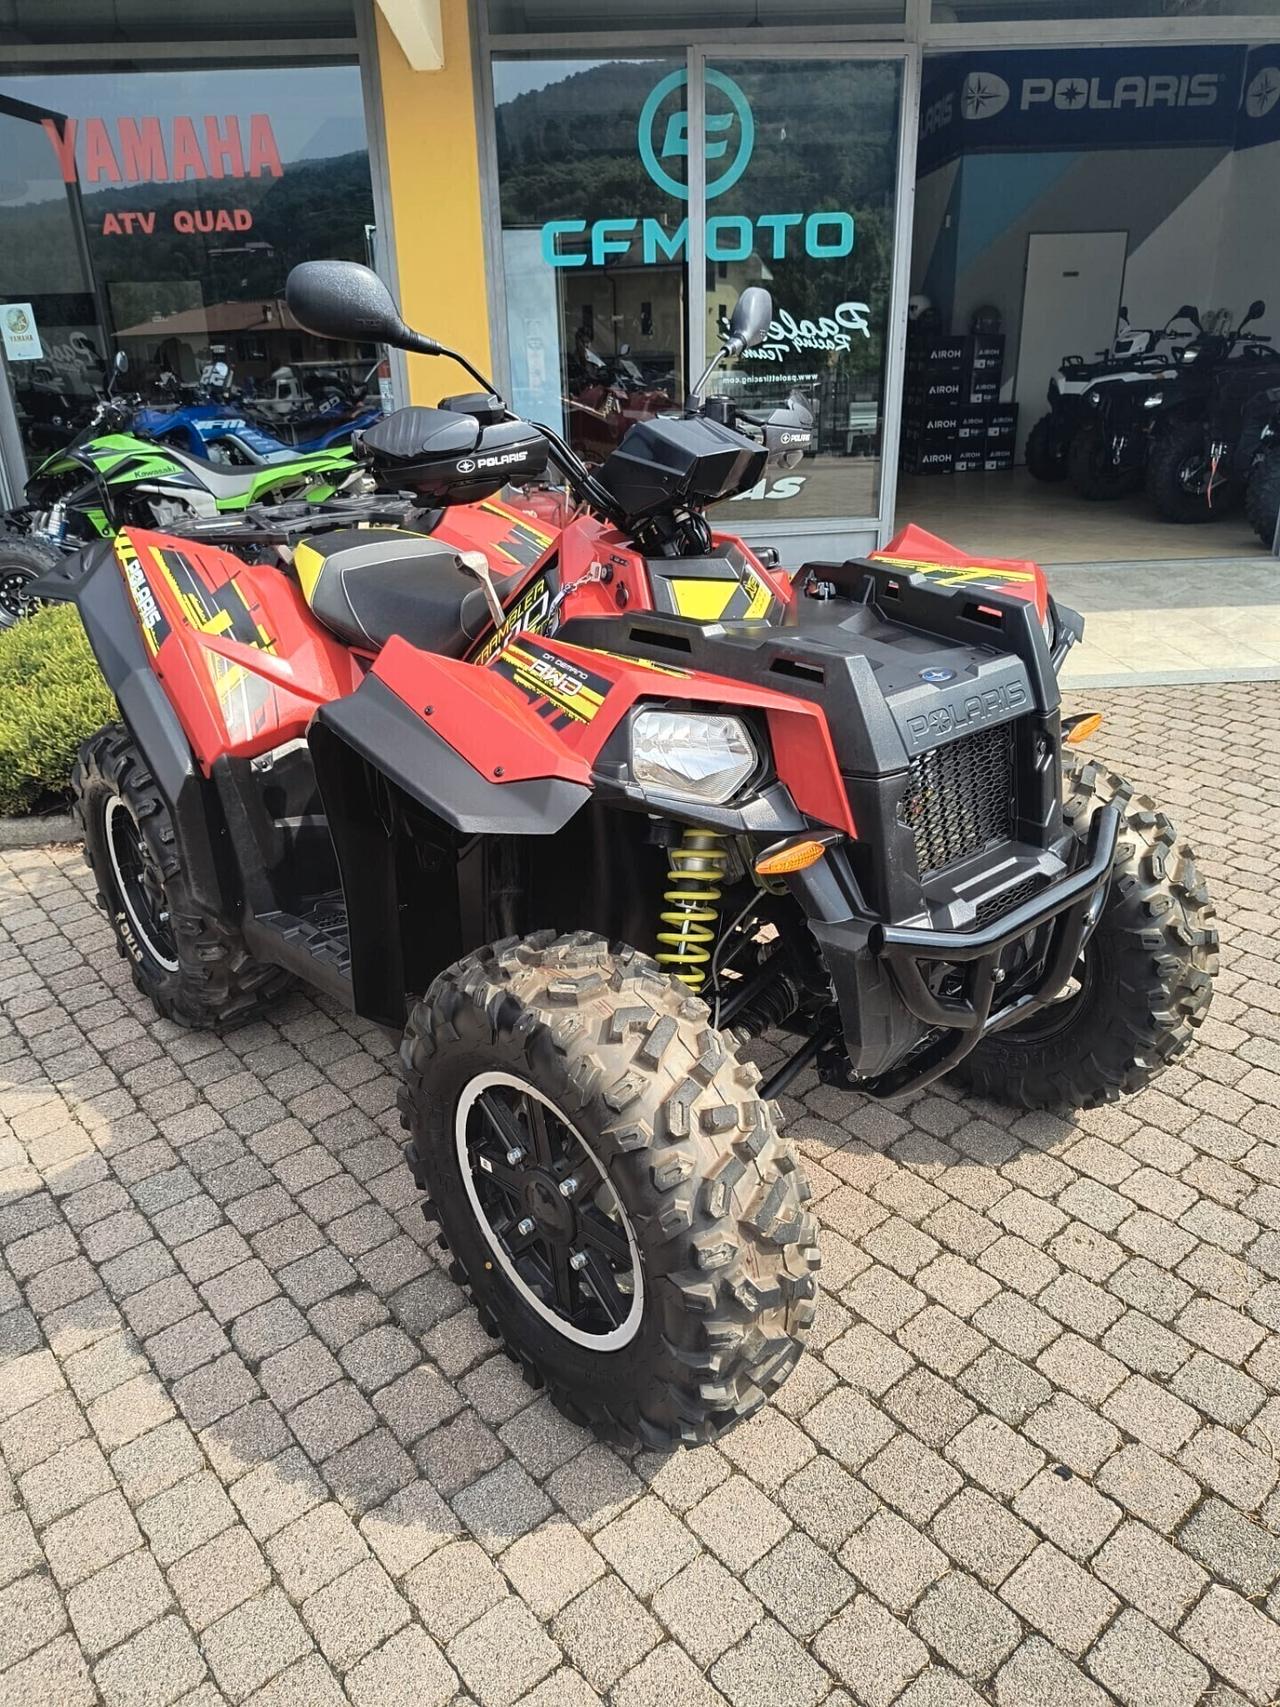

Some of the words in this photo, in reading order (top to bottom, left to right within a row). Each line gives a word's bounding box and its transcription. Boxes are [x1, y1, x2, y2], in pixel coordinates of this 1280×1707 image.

[1020, 74, 1220, 111] POLARIS
[919, 92, 956, 140] LARIS
[40, 113, 284, 184] YAMAHA
[102, 211, 156, 236] ATV
[174, 208, 253, 234] QUAD
[541, 211, 855, 268] CFMOTO
[930, 350, 962, 360] AIROH
[929, 385, 960, 395] AIROH
[927, 419, 957, 430] AIROH
[134, 465, 176, 478] Kawasaki
[477, 451, 529, 469] POLARIS
[922, 454, 953, 464] AIROH
[729, 476, 807, 501] AS
[127, 559, 162, 630] POLARIS
[906, 679, 1028, 745] POLARIS
